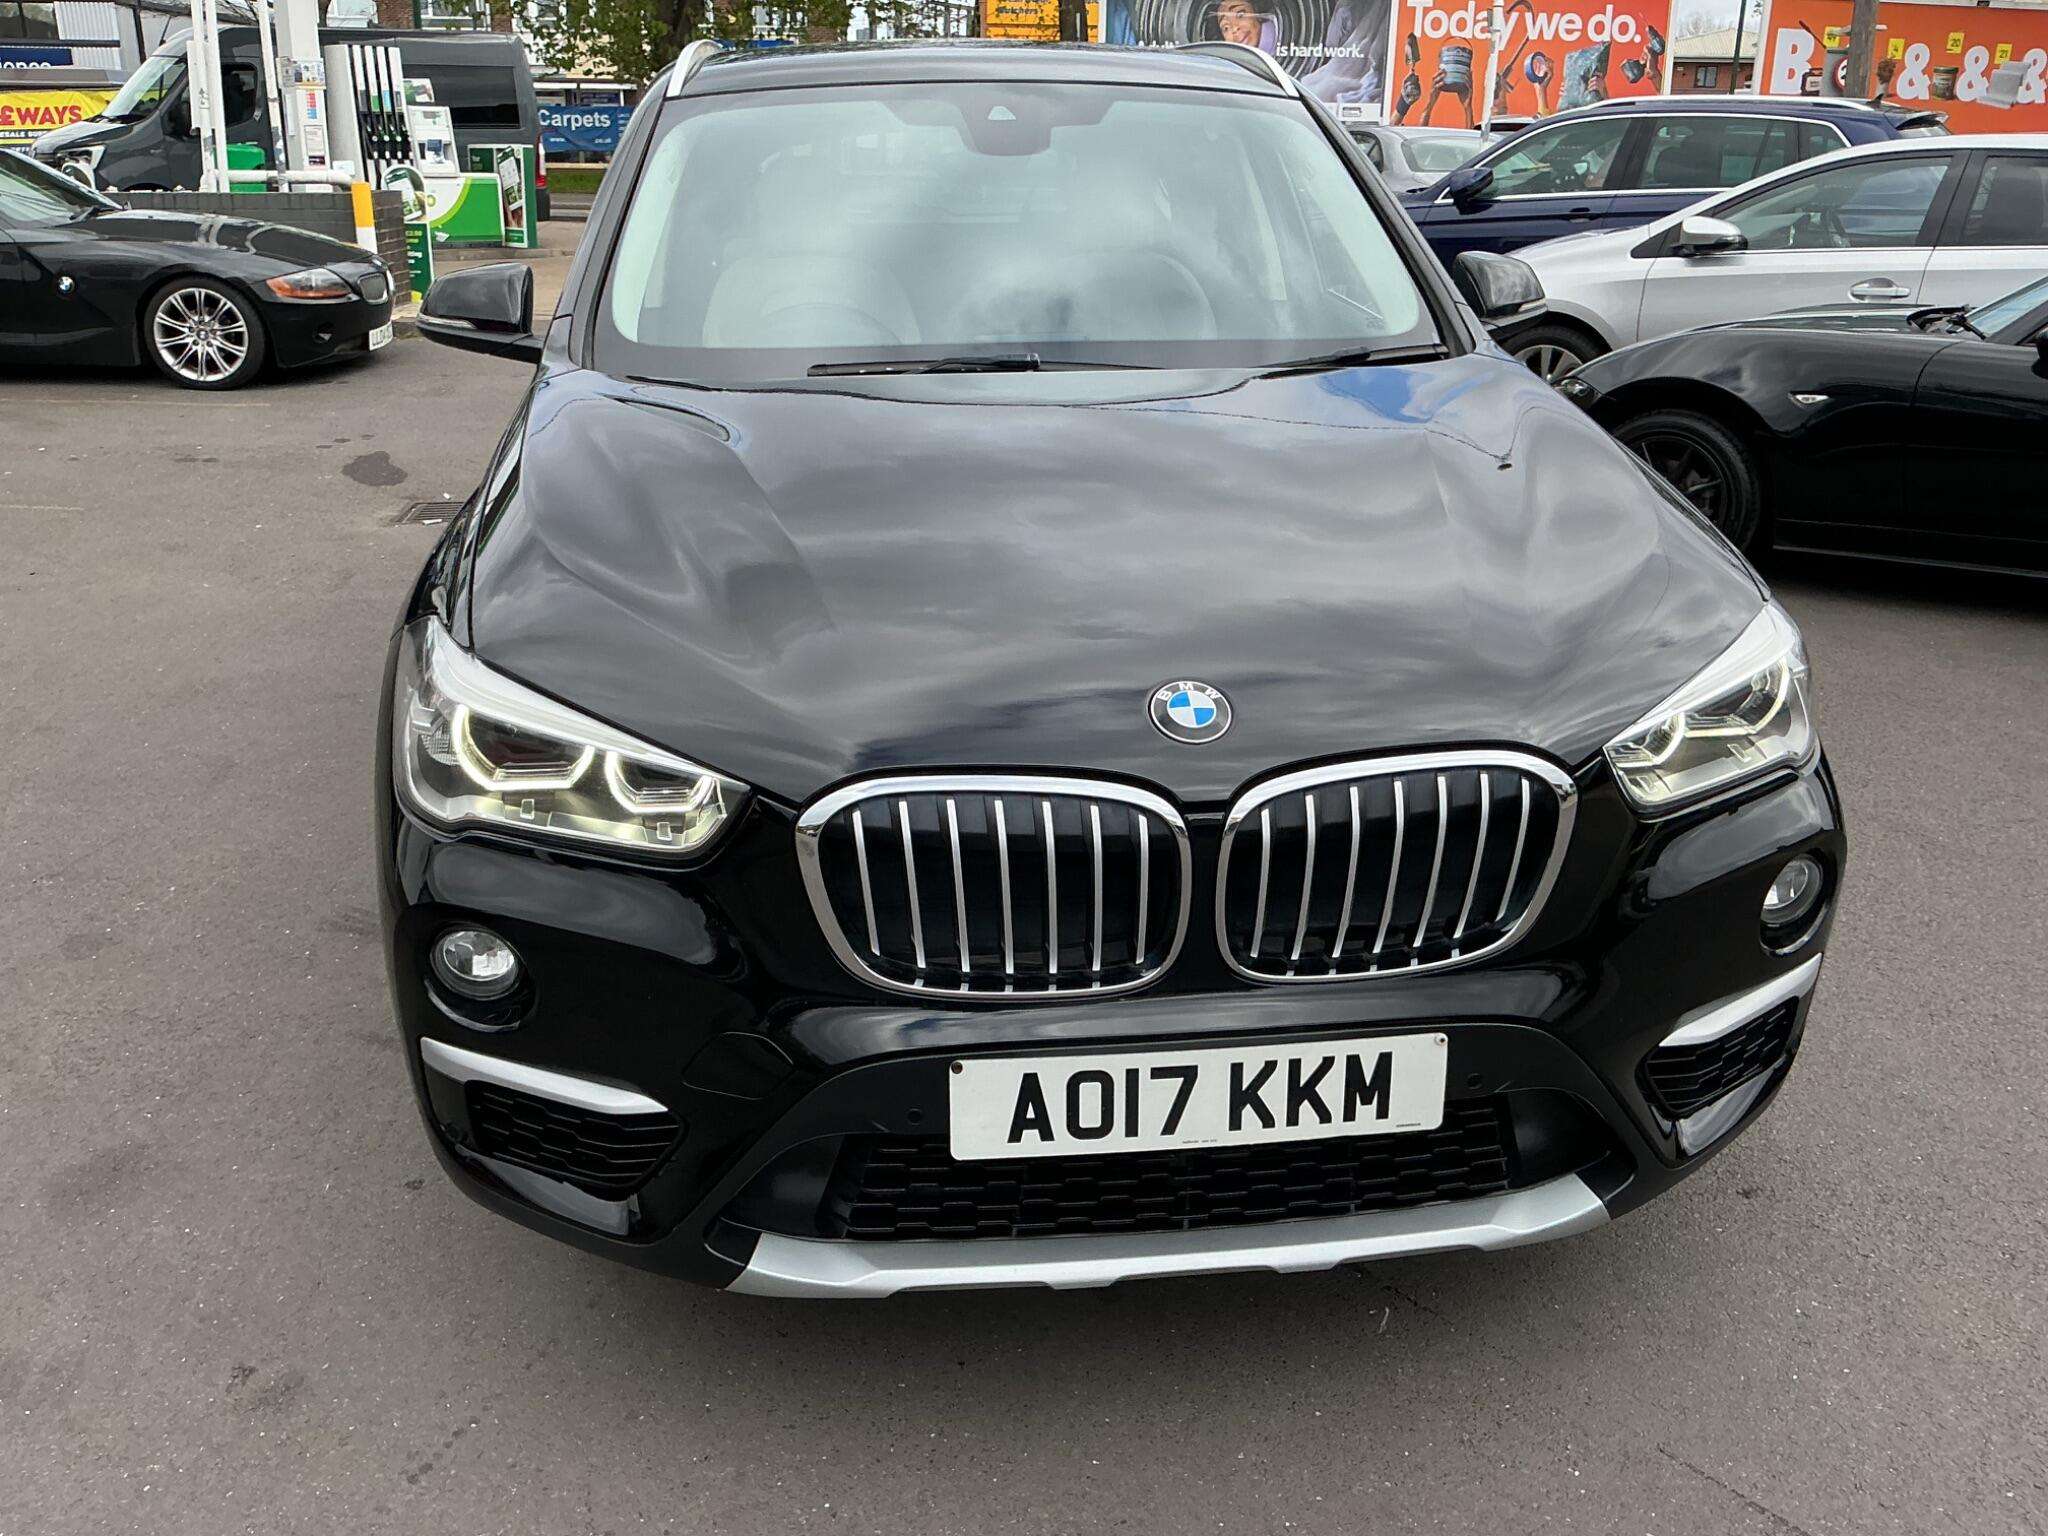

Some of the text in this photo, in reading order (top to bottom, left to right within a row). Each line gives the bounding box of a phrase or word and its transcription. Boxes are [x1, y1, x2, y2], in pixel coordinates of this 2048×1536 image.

[1524, 12, 1582, 41] we
[1587, 4, 1642, 43] do.
[1276, 42, 1364, 58] is hard work.
[538, 109, 611, 131] Carpets
[1156, 682, 1221, 701] BMW
[1007, 1051, 1394, 1144] AO17 KKM
